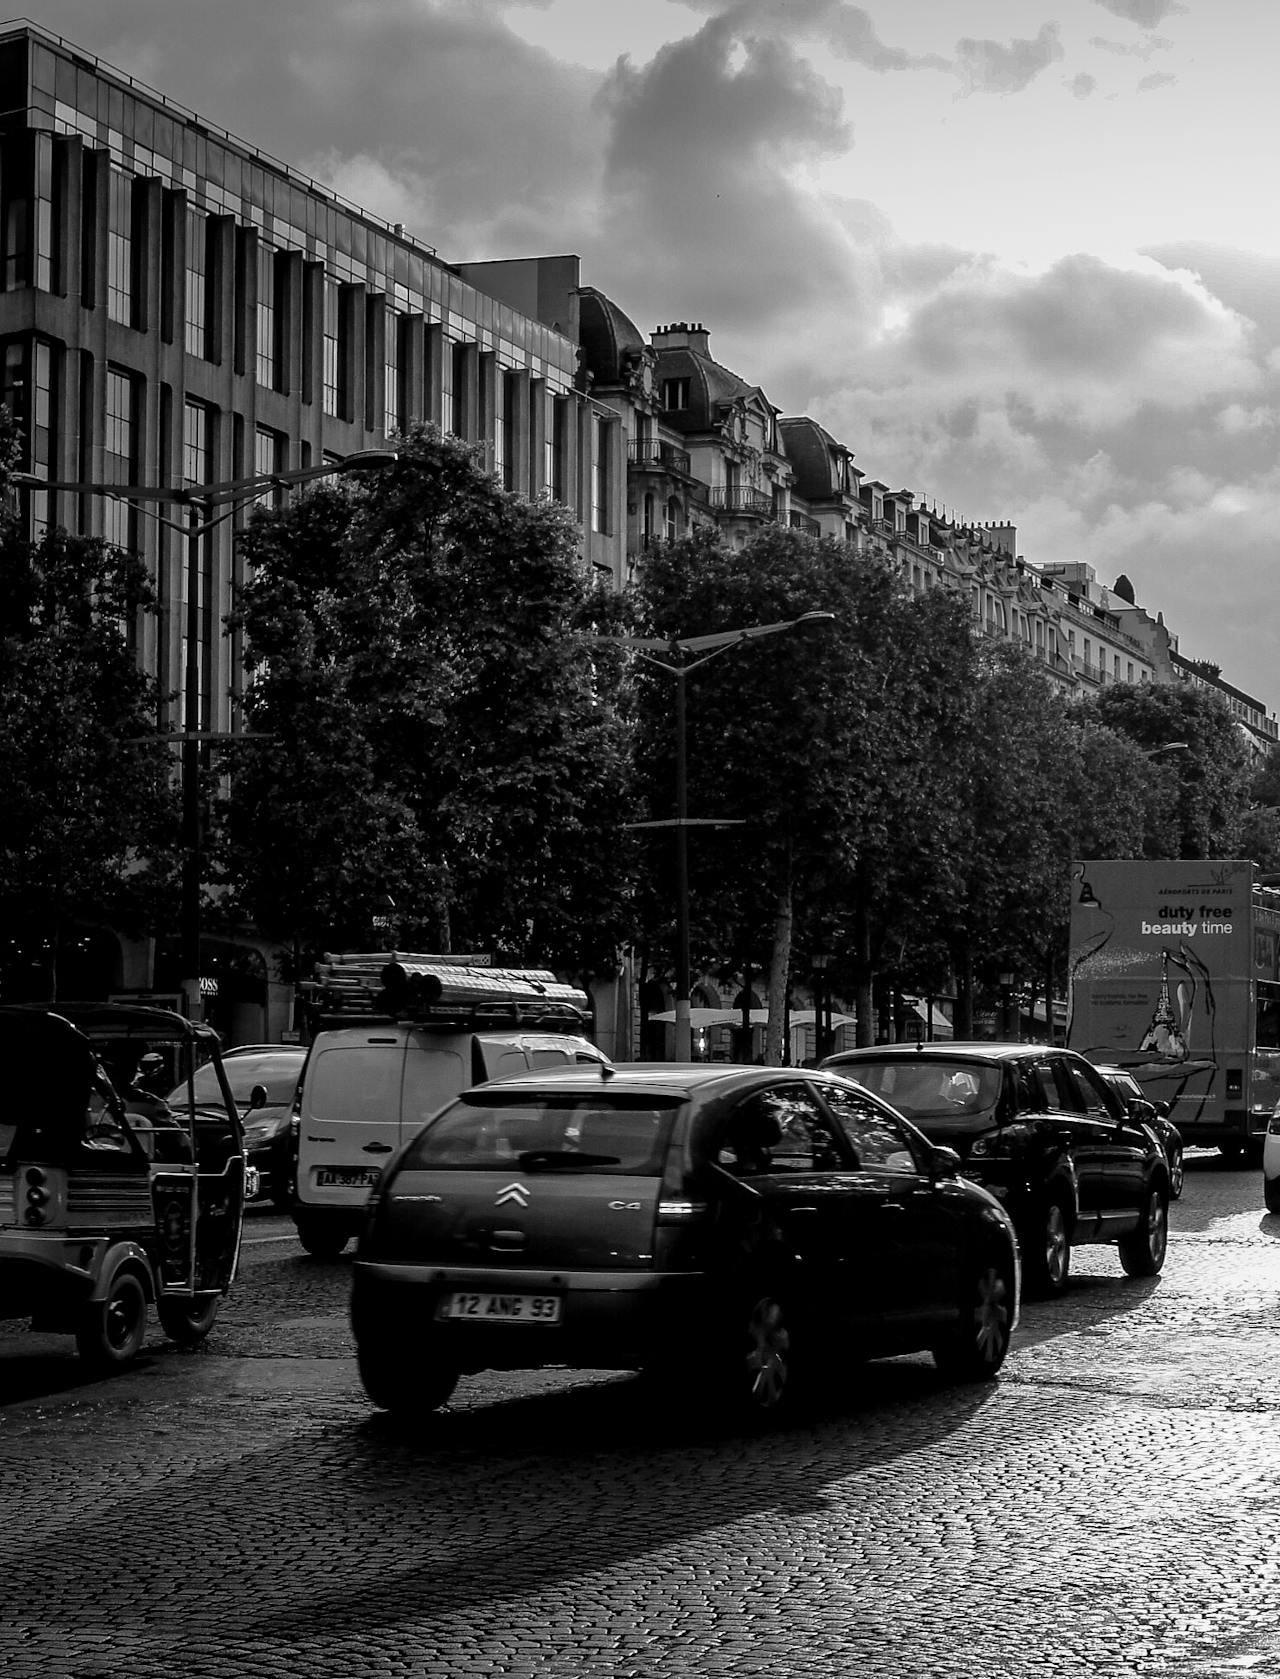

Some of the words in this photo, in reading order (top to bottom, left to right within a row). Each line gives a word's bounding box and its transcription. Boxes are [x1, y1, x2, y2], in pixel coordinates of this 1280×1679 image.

[1158, 905, 1195, 921] duty
[1199, 905, 1233, 918] free
[1141, 921, 1198, 937] beauty
[1201, 920, 1233, 934] time
[199, 976, 219, 991] OSS
[607, 1200, 641, 1210] C4
[460, 1296, 480, 1315] 12
[531, 1299, 555, 1318] 93
